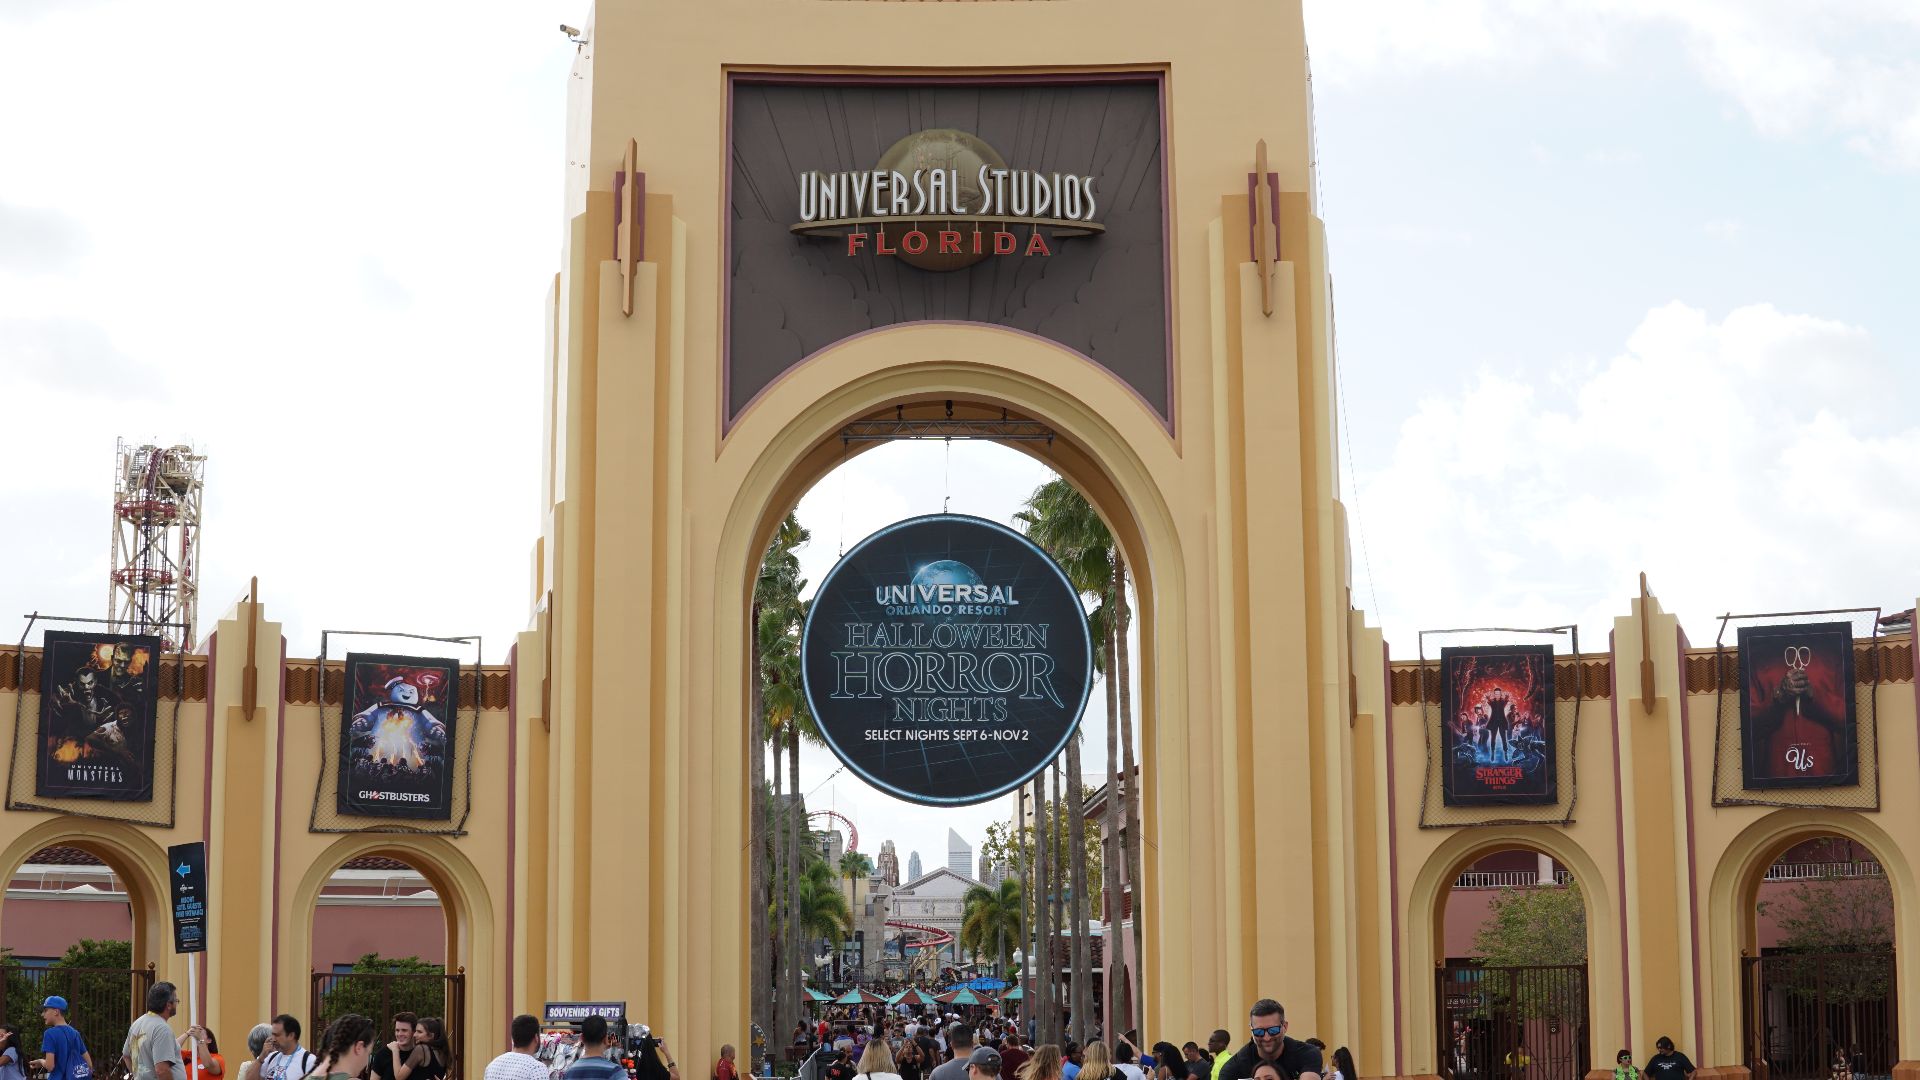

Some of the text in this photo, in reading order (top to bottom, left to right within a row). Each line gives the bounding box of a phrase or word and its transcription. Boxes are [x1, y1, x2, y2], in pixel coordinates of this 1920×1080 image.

[799, 164, 1097, 221] UNIVERSAL STUDIOS
[848, 230, 1051, 256] FLORIDA
[876, 584, 1019, 605] UNIVERSAL
[885, 605, 1008, 616] ORLANDO RESORT
[844, 622, 1050, 649] HALLOWEEN
[830, 652, 1065, 708] HORROR
[892, 697, 1008, 722] NIGHTS
[864, 729, 902, 741] SELECT
[905, 729, 950, 741] NIGHTS
[953, 729, 978, 741] SEPT
[1785, 746, 1814, 771] Us
[67, 769, 123, 783] MONSTERS
[1475, 767, 1523, 779] STRANGER
[1484, 776, 1517, 785] THINGS
[358, 790, 430, 803] GHOSTBUSTERS
[549, 1007, 590, 1017] SOUVENIRS
[598, 1007, 620, 1017] GIFTS
